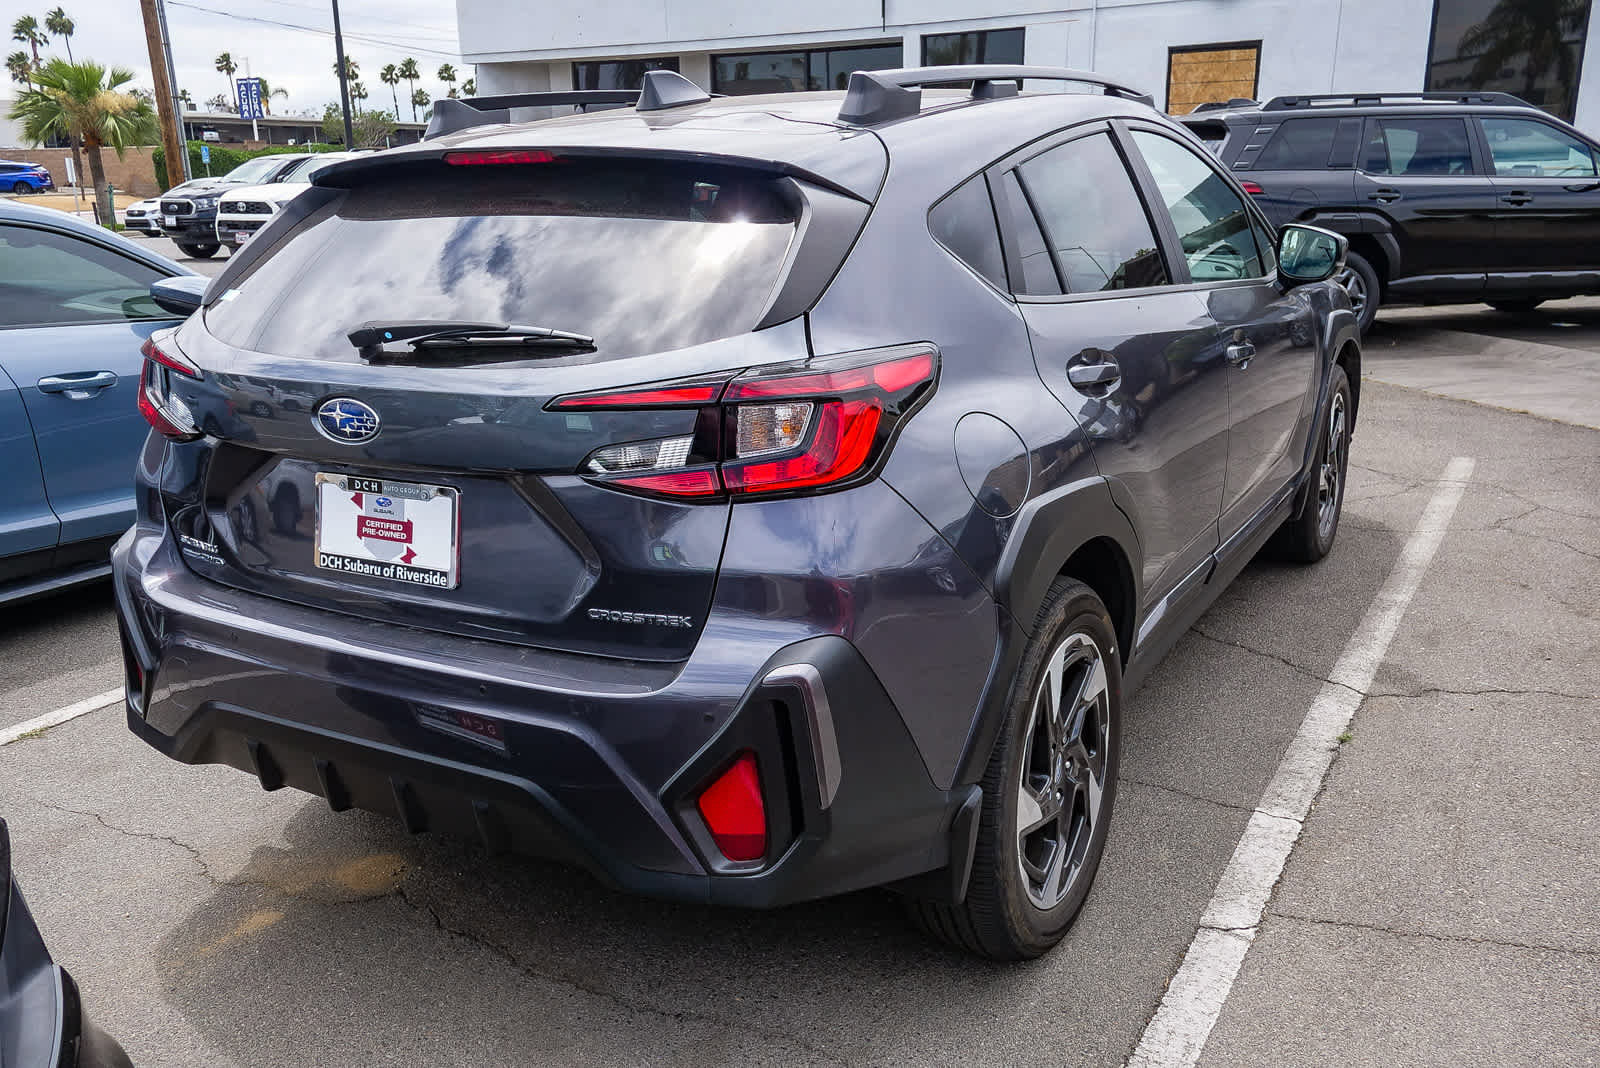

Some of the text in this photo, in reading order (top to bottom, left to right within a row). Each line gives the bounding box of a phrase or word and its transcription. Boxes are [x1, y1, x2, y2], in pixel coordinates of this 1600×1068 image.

[240, 84, 250, 118] ACURA
[354, 479, 378, 492] DCH
[362, 527, 407, 540] PRE-OWNED
[365, 519, 403, 532] CERTIFIED
[320, 554, 447, 586] DCH Subaru of Riverside
[588, 608, 693, 628] CROSSTREK
